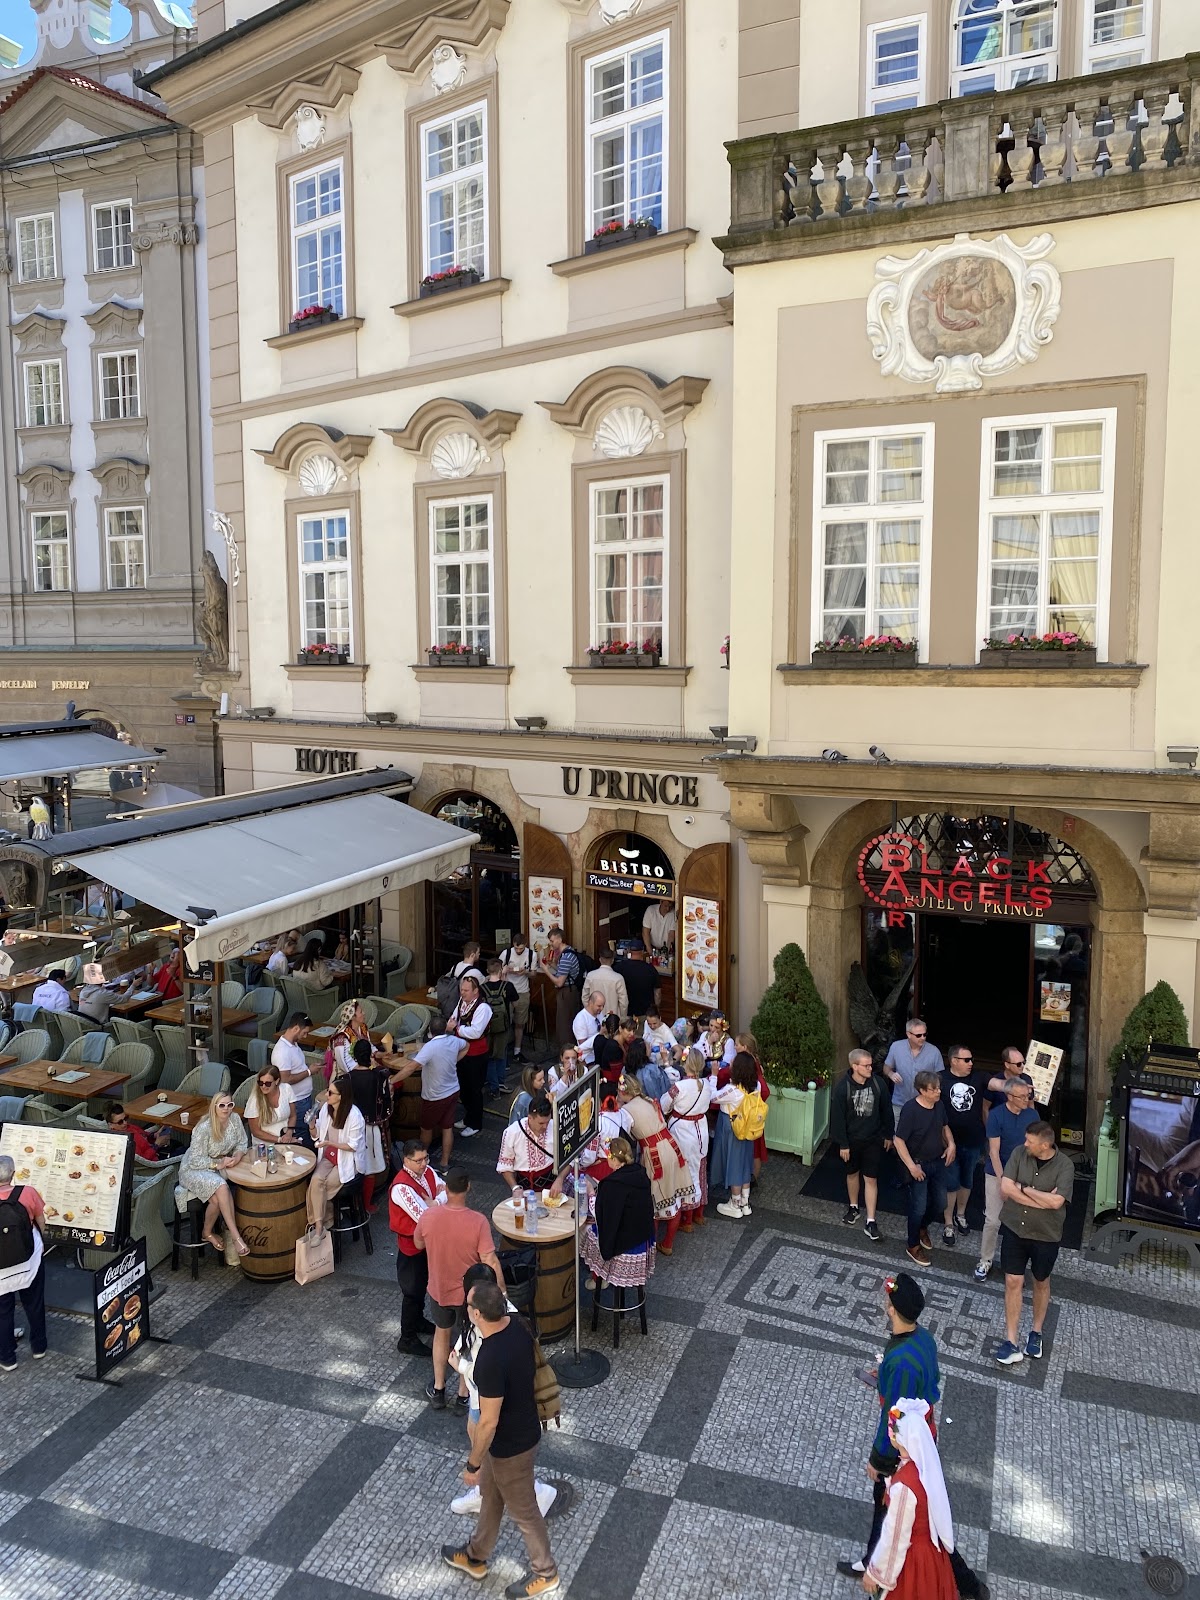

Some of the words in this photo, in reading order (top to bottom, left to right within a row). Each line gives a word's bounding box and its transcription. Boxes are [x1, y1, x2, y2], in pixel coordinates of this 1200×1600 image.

[0, 680, 37, 689] RCELAIN
[52, 680, 90, 691] JEWELRY
[294, 747, 363, 775] HOTEL
[561, 766, 582, 795] U
[588, 768, 699, 808] PRINCE
[600, 859, 665, 878] BISTRO
[881, 843, 1053, 884] BLACK
[879, 869, 1053, 909] ANGEL'S
[904, 895, 955, 911] HOTEL
[963, 898, 974, 912] U
[984, 900, 1044, 918] PRINCE
[559, 1100, 577, 1123] Pivo
[101, 1282, 120, 1305] Street
[120, 1270, 135, 1289] Food
[814, 1262, 992, 1323] HOEL
[763, 1280, 801, 1302] U
[811, 1290, 1006, 1358] PRCE
